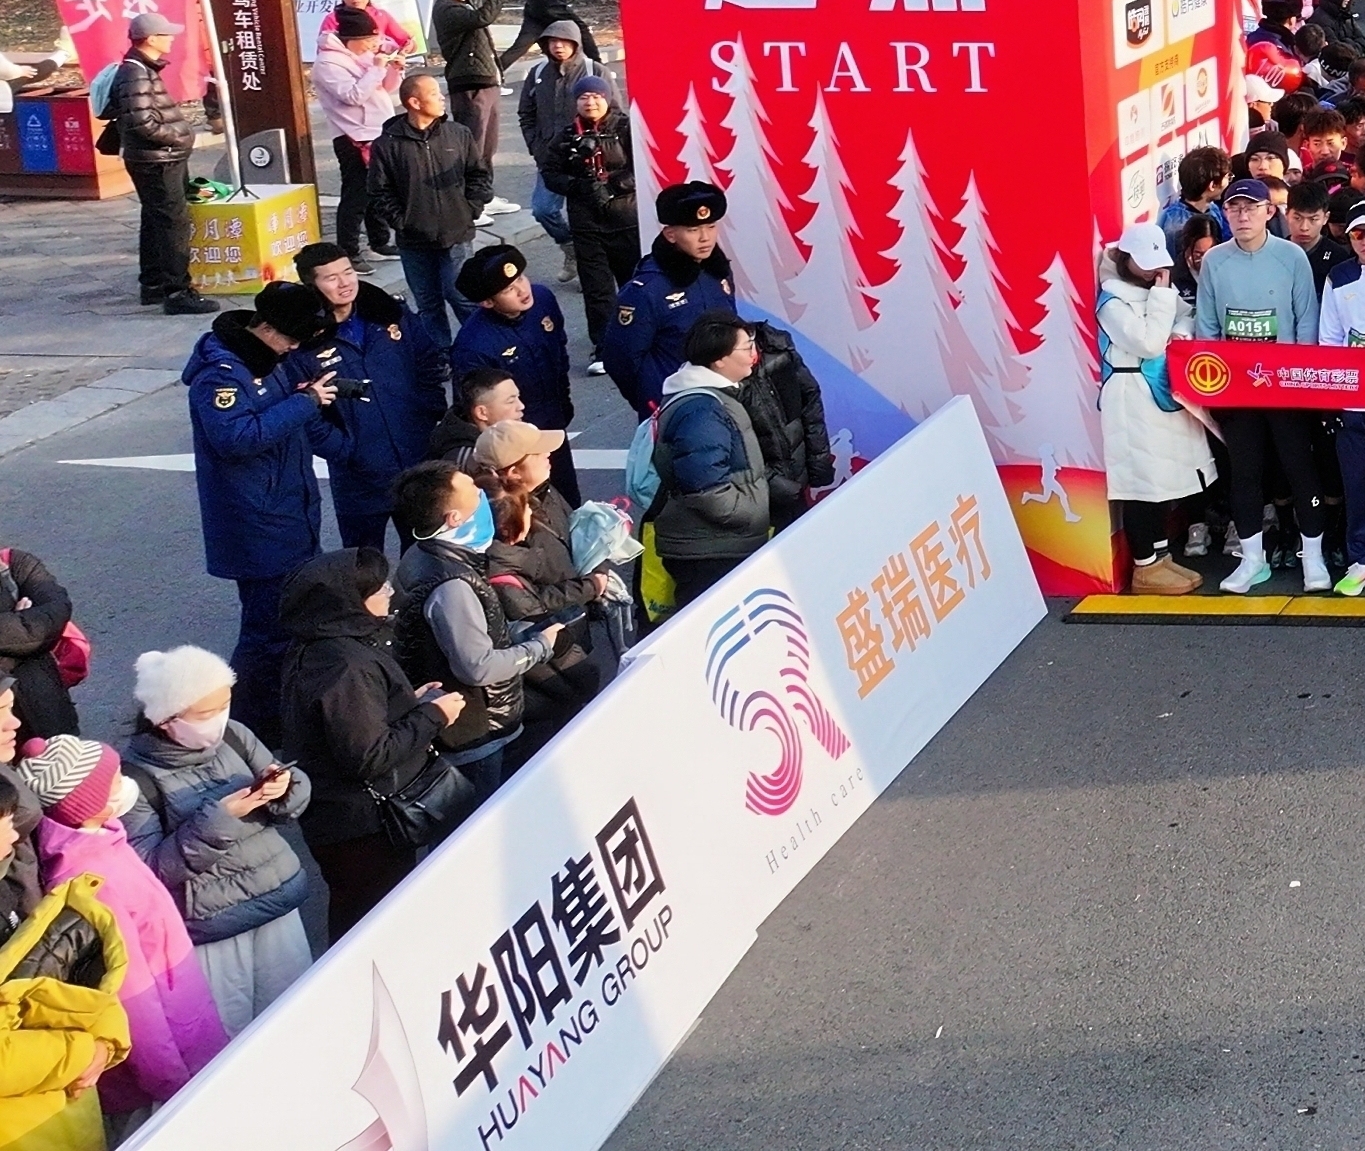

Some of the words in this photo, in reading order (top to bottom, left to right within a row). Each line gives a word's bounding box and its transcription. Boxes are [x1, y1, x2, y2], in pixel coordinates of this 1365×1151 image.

[709, 40, 996, 93] START
[1227, 320, 1271, 333] A0151
[1277, 367, 1360, 384] 中国体育彩票
[833, 493, 993, 701] 盛瑞医疗
[766, 807, 823, 876] Health
[831, 765, 866, 808] care
[436, 795, 667, 1099] 华阳集团
[601, 905, 675, 1008] GROUP
